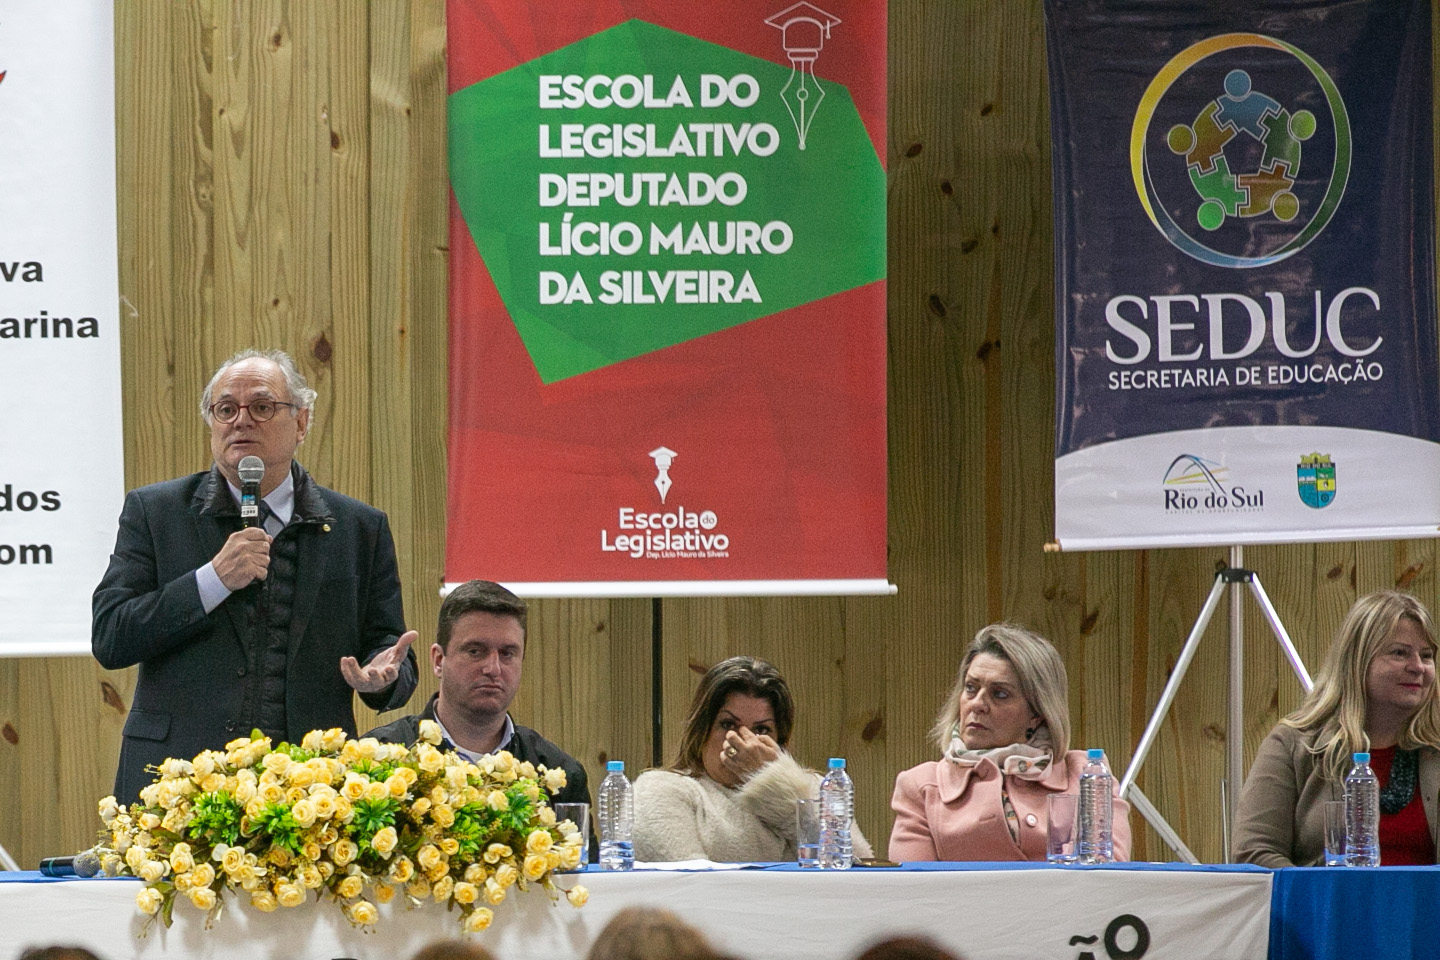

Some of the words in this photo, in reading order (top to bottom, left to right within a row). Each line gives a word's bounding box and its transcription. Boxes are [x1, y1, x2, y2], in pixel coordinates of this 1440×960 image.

[539, 75, 695, 110] ESCOLA
[700, 74, 761, 109] DO
[539, 123, 781, 159] LEGISLATIVO
[539, 172, 749, 208] DEPUTADO
[539, 212, 644, 257] LÍCIO
[649, 221, 795, 256] MAURO
[539, 271, 594, 306] DA
[600, 270, 763, 306] SILVEIRA
[1105, 286, 1384, 365] SEDUC
[1108, 368, 1230, 390] SECRETARIA
[1235, 366, 1262, 386] DE
[1267, 359, 1384, 385] EDUCAÇÃO
[1163, 488, 1198, 510] Rio
[1204, 491, 1228, 509] do
[1231, 486, 1264, 508] Sul
[619, 506, 698, 529] Escola
[601, 529, 730, 558] Legislativo
